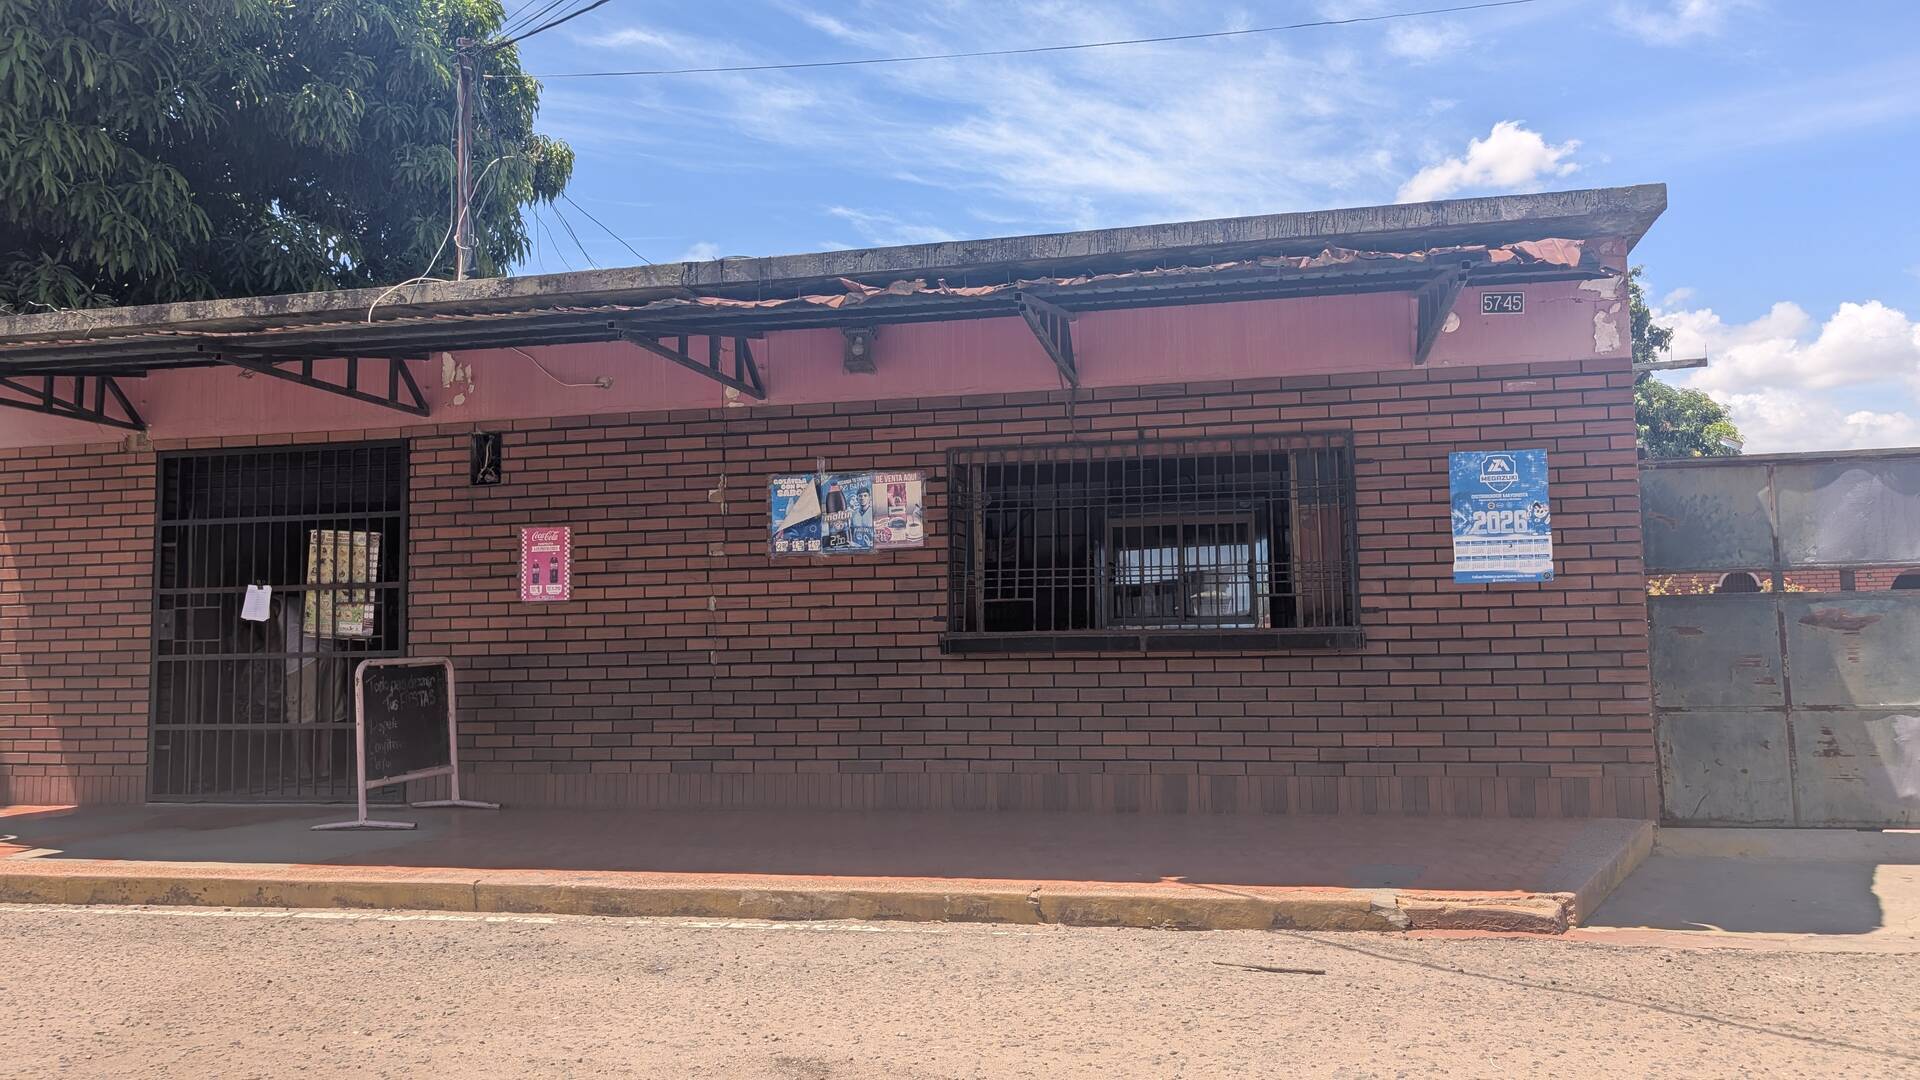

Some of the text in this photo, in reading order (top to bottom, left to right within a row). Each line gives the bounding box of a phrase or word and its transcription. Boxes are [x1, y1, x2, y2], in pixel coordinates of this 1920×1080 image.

[875, 474, 883, 483] DE
[884, 473, 903, 482] VENTA
[1471, 510, 1528, 535] 2026
